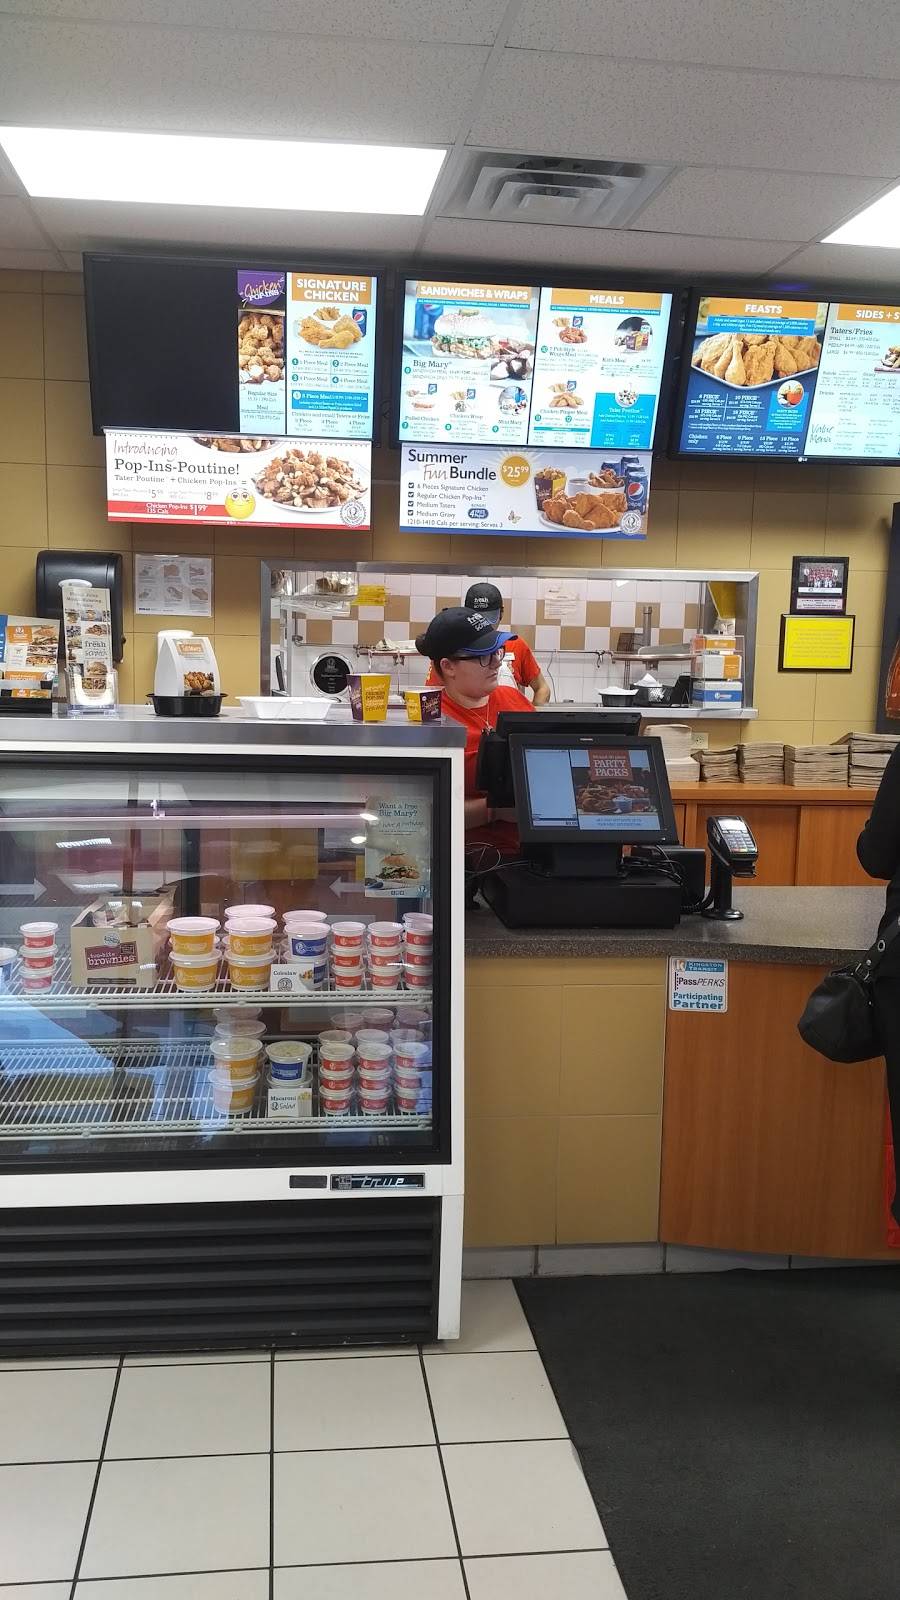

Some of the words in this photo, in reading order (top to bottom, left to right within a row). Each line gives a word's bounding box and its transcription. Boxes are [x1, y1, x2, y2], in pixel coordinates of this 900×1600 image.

[297, 279, 366, 292] SIGNATURE
[304, 290, 360, 302] CHICKEN
[420, 286, 484, 298] SANDWICHES
[486, 290, 492, 298] &
[494, 290, 528, 300] WRAPS
[590, 294, 624, 305] MEALS
[745, 304, 782, 314] FEASTS
[856, 310, 884, 319] SIDES
[830, 326, 873, 335] Taters/Fries
[413, 360, 426, 369] Big
[114, 440, 178, 460] Introducing
[408, 449, 467, 464] Summer
[115, 458, 239, 476] Pop-Ins-Poutine!
[424, 464, 447, 480] Fun
[450, 466, 496, 481] Bundle
[593, 760, 626, 768] PARTY
[596, 768, 629, 777] PACKS
[87, 955, 136, 966] brownies
[679, 977, 725, 987] PassPERKS
[673, 992, 723, 1002] Participating
[673, 1000, 723, 1009] Partner
[361, 1175, 405, 1188] true
